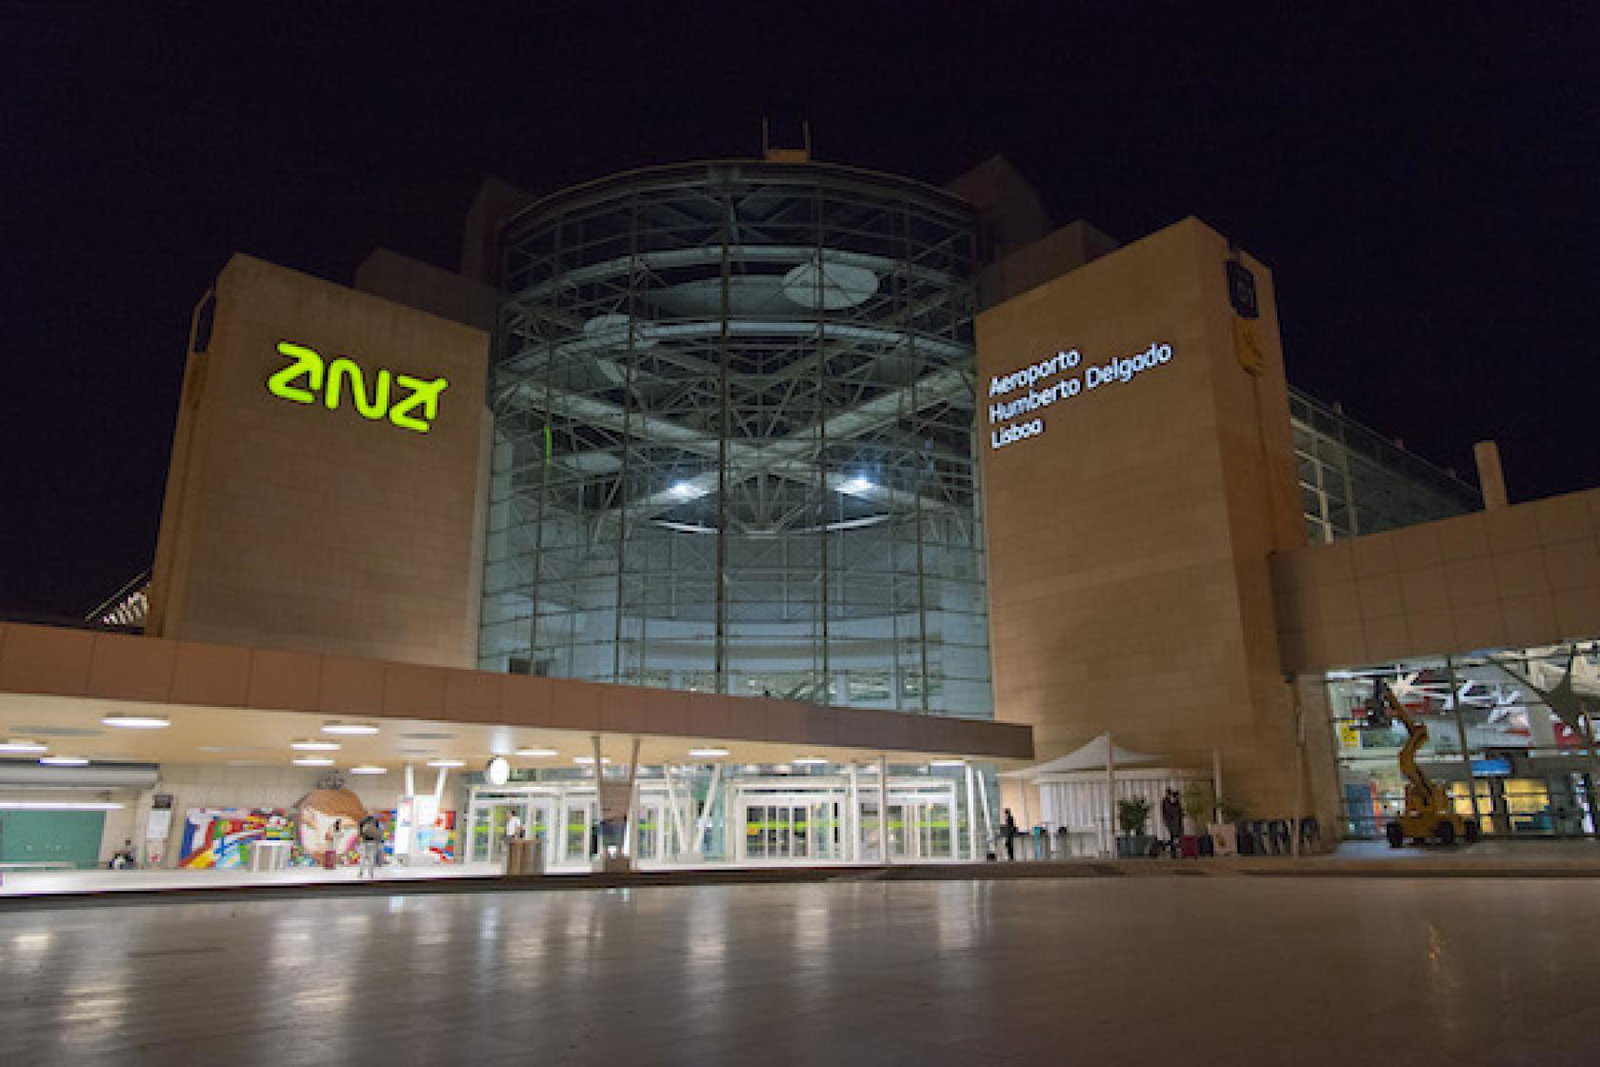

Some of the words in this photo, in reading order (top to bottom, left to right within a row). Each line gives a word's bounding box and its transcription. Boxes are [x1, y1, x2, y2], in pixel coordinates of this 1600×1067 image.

[989, 349, 1082, 398] Aeroporto
[989, 378, 1082, 424] Humberto
[1085, 342, 1173, 390] Delgado
[991, 418, 1045, 449] Lisboa
